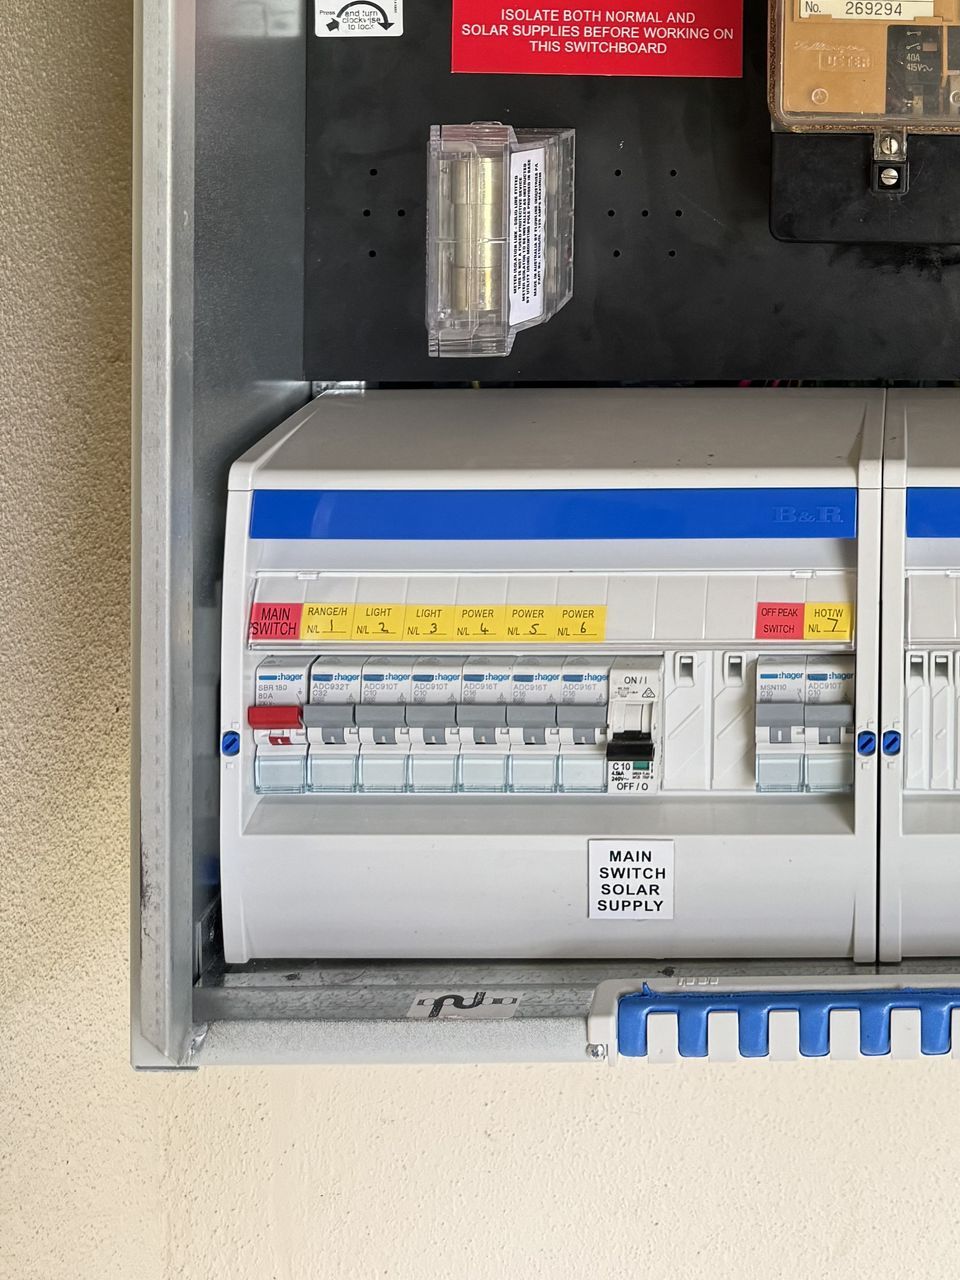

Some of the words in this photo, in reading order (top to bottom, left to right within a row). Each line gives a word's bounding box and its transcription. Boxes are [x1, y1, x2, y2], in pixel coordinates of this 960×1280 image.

[805, 1, 821, 13] No.
[845, 1, 902, 16] 269294
[502, 9, 559, 21] ISOLATE
[564, 10, 601, 22] BOTH
[606, 11, 662, 23] NORMAL
[666, 12, 695, 23] AND
[462, 24, 508, 36] SOLAR
[512, 25, 580, 37] SUPPLIES
[584, 26, 639, 38] BEFORE
[644, 28, 710, 39] WORKING
[713, 28, 733, 40] ON
[530, 40, 560, 52] THIS
[564, 41, 667, 54] SWITCHBOARD
[261, 608, 290, 620] MAIN
[308, 607, 348, 616] RANGE/H
[366, 608, 392, 617] LIGHT
[416, 609, 442, 618] LIGHT
[462, 610, 494, 618] POWER
[512, 610, 544, 618] POWER
[562, 610, 594, 618] POWER
[761, 608, 776, 616] OFF
[778, 608, 798, 616] PEAK
[814, 609, 843, 617] HOT/W
[251, 622, 297, 635] SWITCH
[307, 625, 320, 633] N/L
[357, 625, 369, 634] N/L
[763, 624, 794, 633] SWITCH
[808, 624, 820, 632] N/L
[827, 618, 838, 632] 7
[407, 626, 420, 635] N/L
[457, 627, 470, 636] N/L
[507, 627, 520, 636] N/L
[557, 627, 570, 636] N/L
[624, 676, 637, 684] ON
[617, 783, 634, 791] OFF
[610, 851, 652, 862] MAIN
[600, 867, 665, 879] SWITCH
[601, 884, 660, 895] SOLAR
[597, 900, 663, 911] SUPPLY
